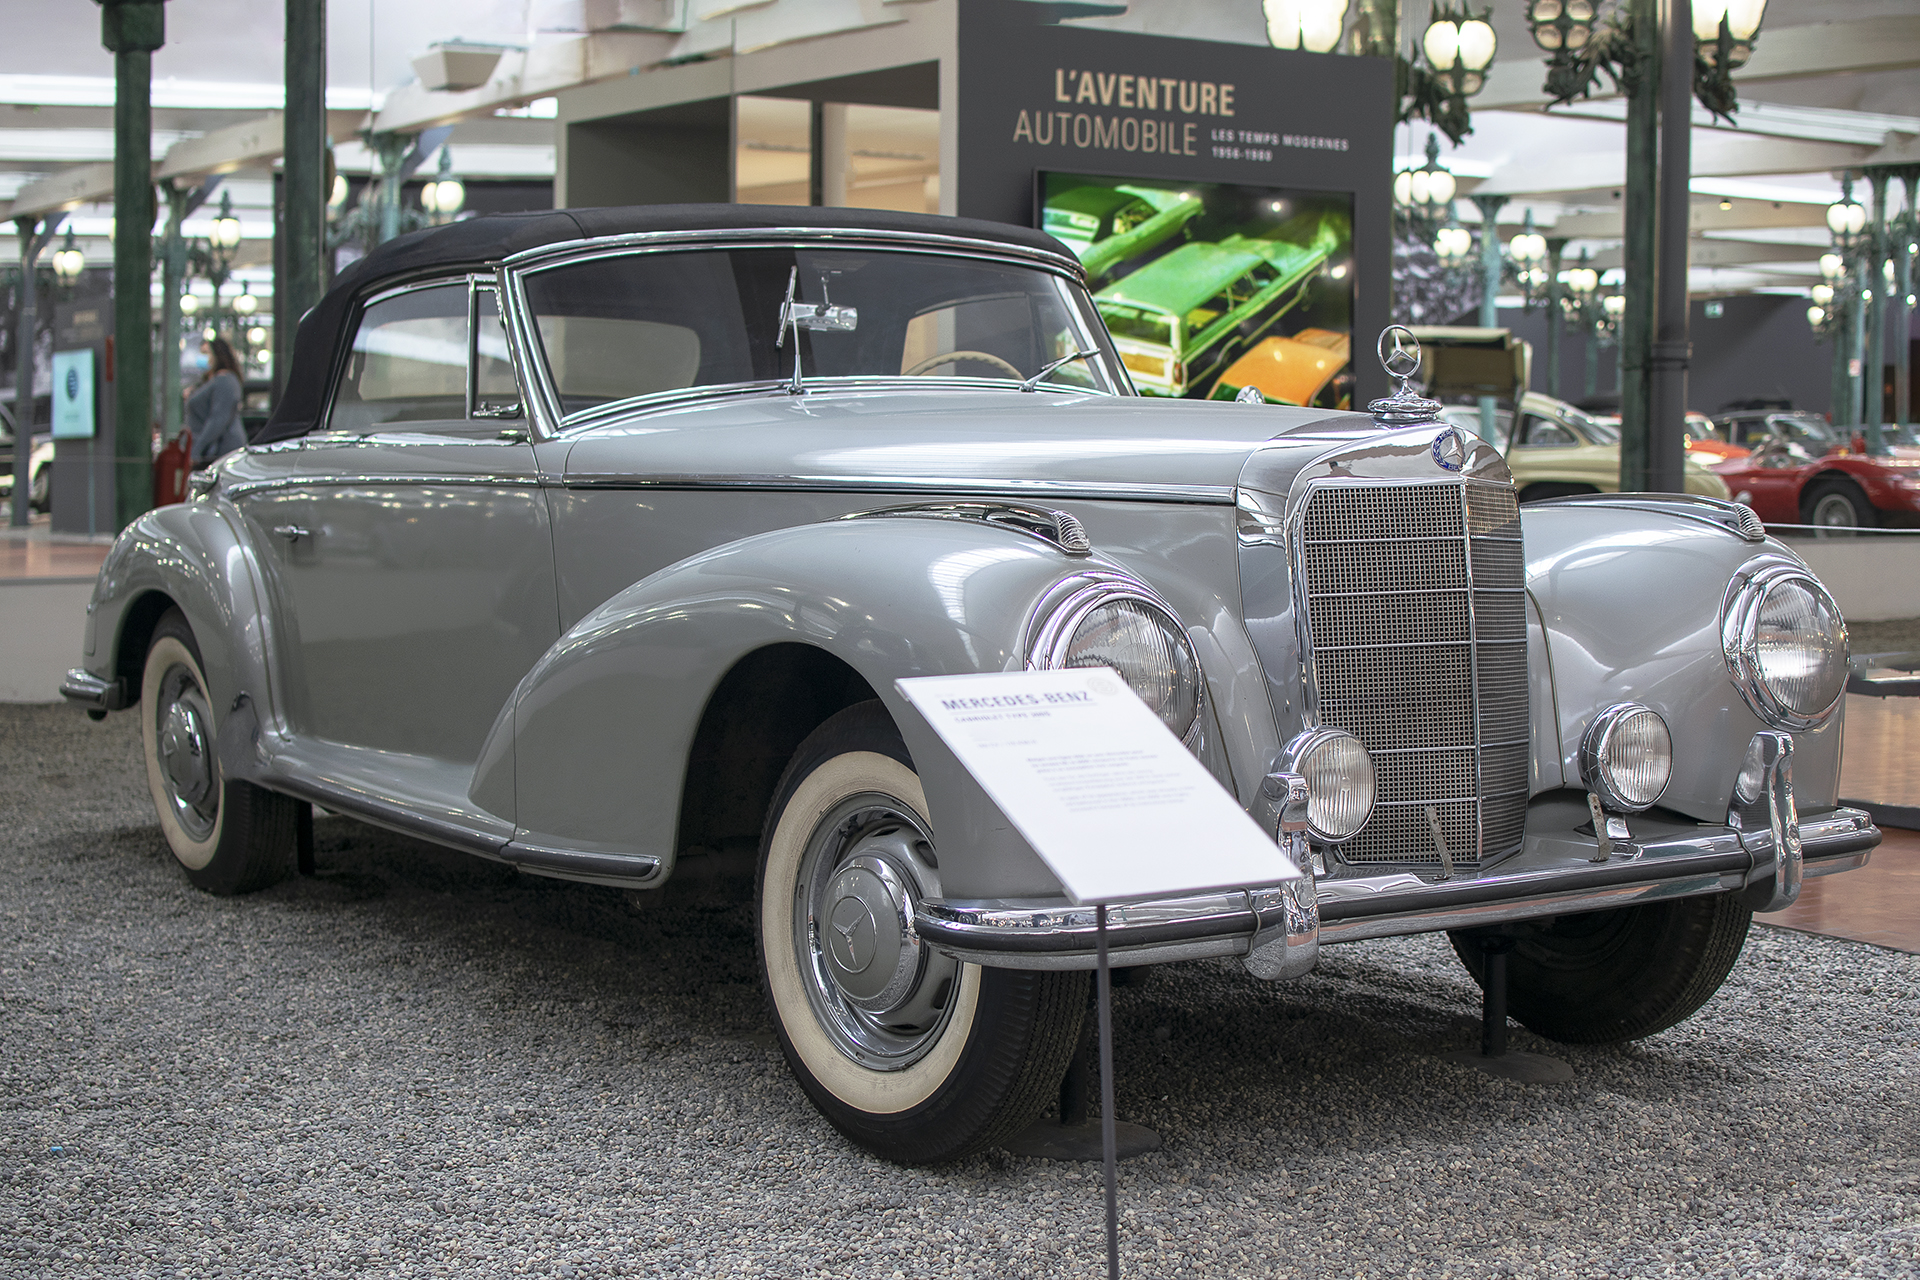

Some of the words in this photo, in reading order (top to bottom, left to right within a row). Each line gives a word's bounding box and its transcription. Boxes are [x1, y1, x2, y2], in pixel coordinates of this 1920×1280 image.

[1055, 68, 1236, 117] L'AVENTURE
[1013, 109, 1198, 156] AUTOMOBILE
[1211, 128, 1235, 142] LES
[1238, 130, 1280, 146] TEMPS
[1282, 134, 1349, 151] MODERNES
[941, 690, 1093, 711] MERCEDES-BENZ
